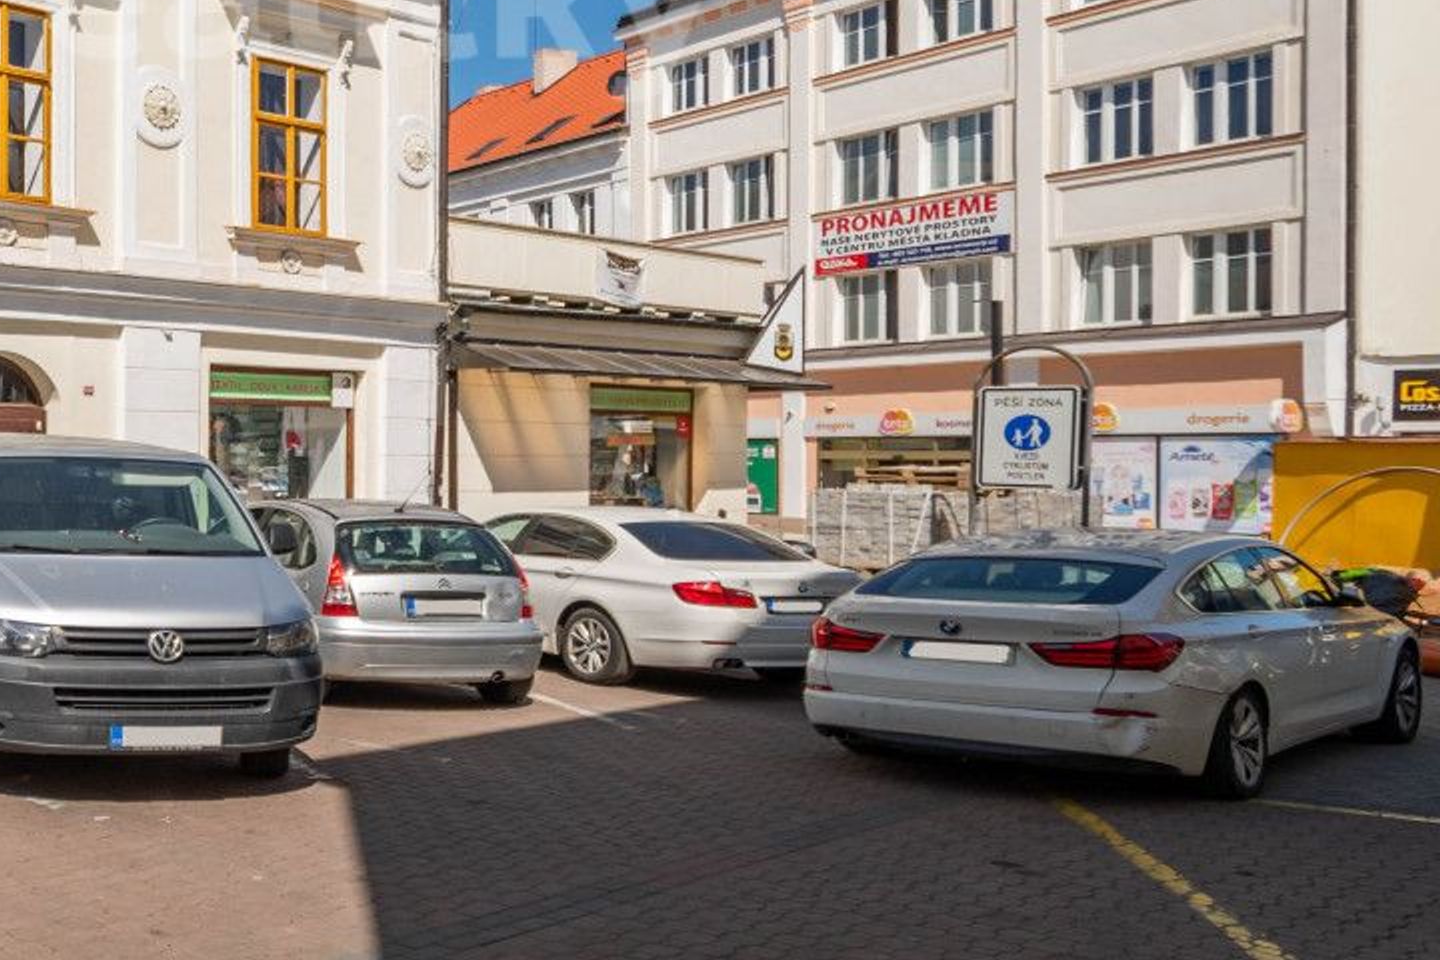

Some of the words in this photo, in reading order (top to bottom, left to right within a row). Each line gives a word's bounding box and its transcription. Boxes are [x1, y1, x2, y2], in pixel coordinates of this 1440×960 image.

[822, 193, 998, 236] PRONAJMEME
[934, 225, 992, 242] KLADNA
[1186, 412, 1250, 428] drogerie
